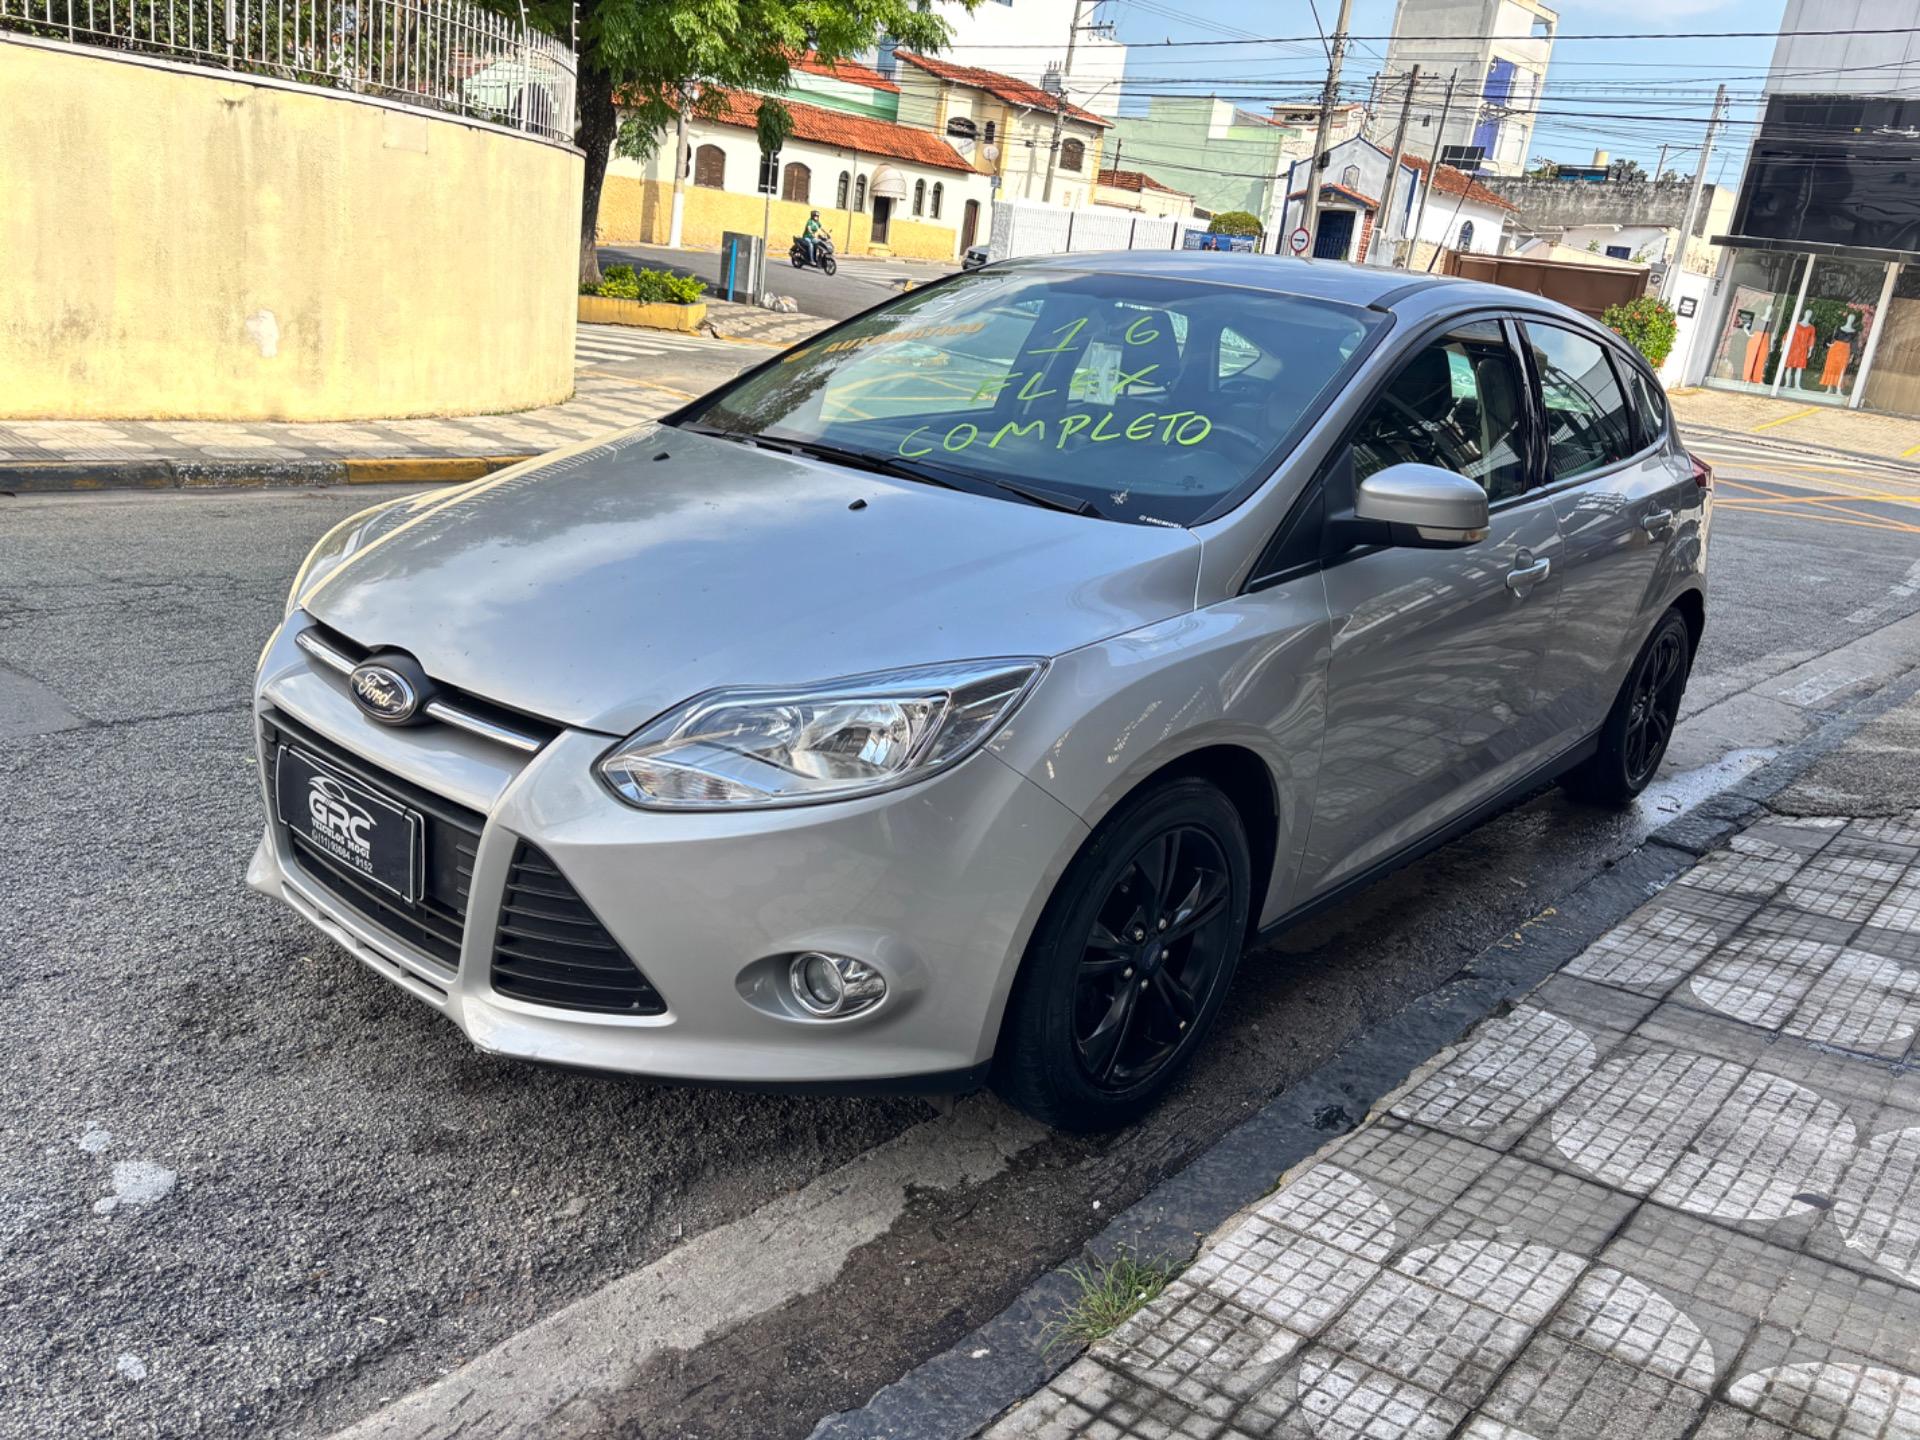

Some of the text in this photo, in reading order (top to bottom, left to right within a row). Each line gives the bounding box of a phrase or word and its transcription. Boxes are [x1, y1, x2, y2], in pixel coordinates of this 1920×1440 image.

[1027, 318, 1088, 354] 1
[969, 364, 1160, 405] FLEX
[899, 411, 1212, 457] COMPLETO
[358, 672, 395, 707] Ford
[308, 789, 371, 850] GRC
[347, 839, 370, 860] MOGI
